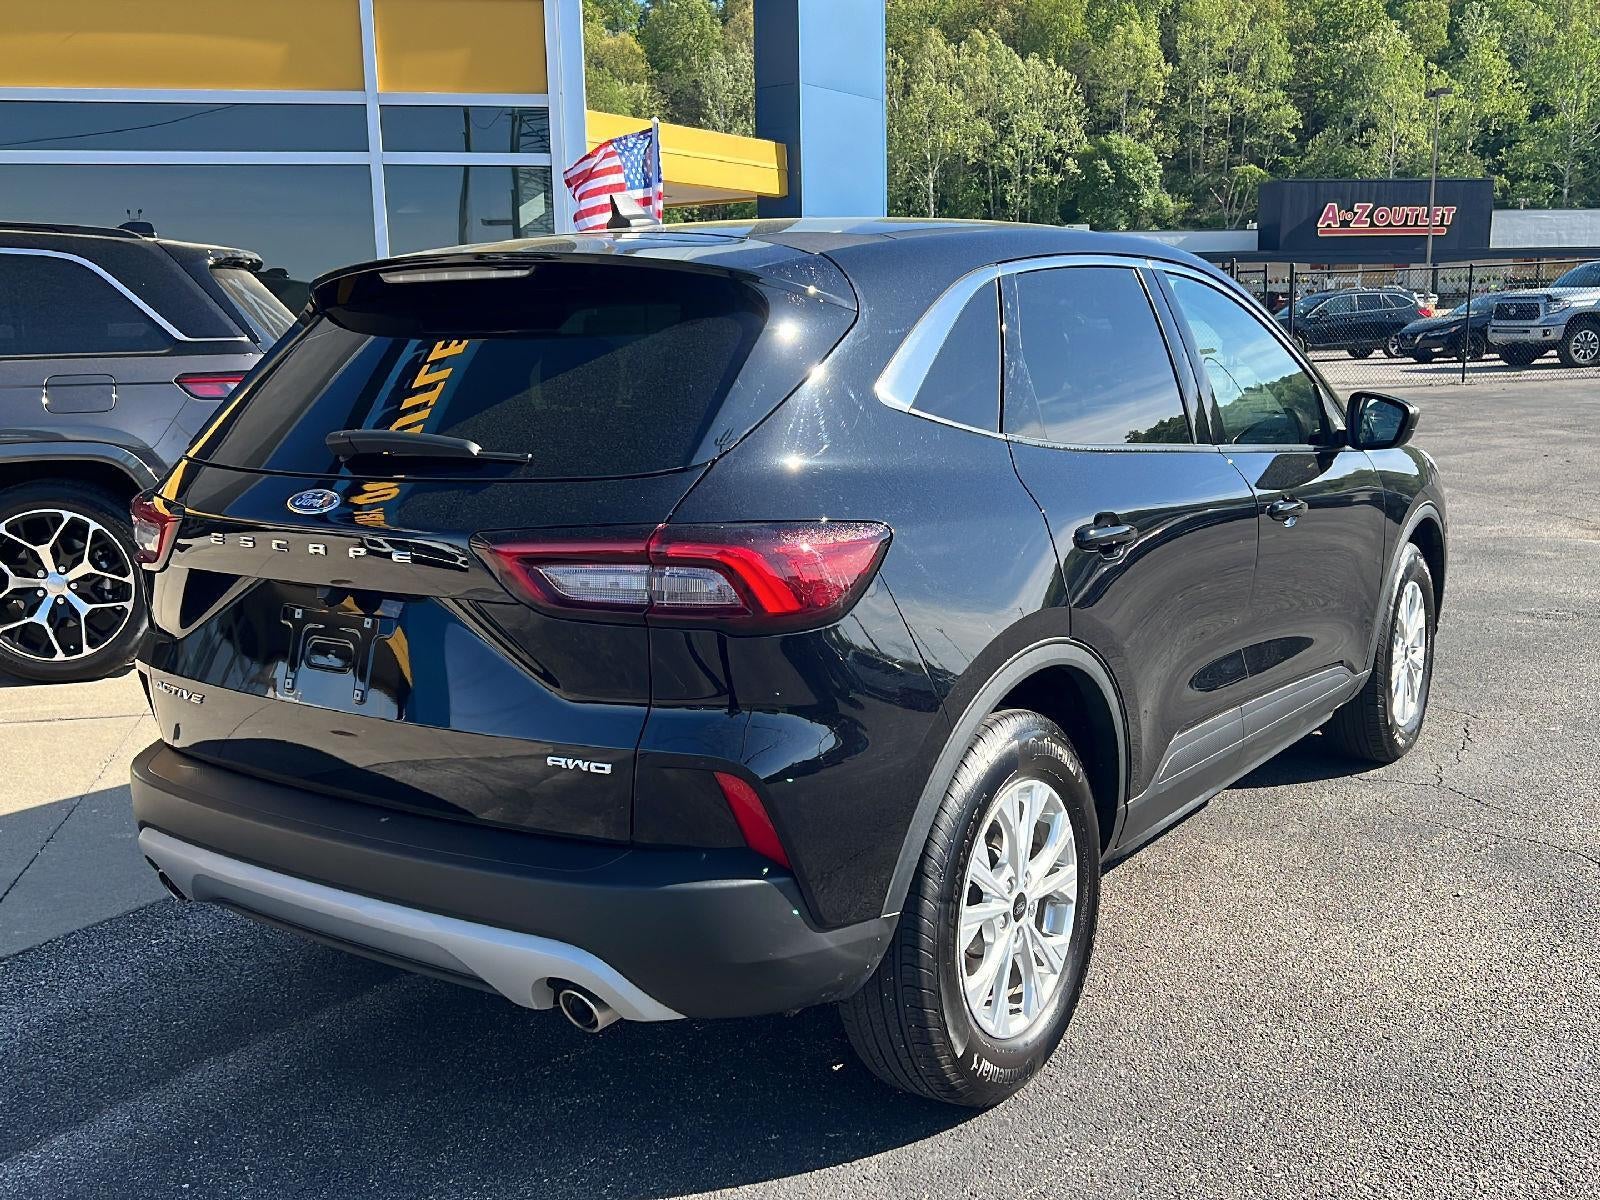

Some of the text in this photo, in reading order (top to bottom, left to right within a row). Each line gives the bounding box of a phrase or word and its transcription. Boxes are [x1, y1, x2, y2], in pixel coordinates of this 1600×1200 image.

[1373, 207, 1457, 226] OUTLET
[209, 532, 413, 564] ESCAPE
[155, 680, 205, 704] ACTIVE
[546, 756, 612, 775] AWD
